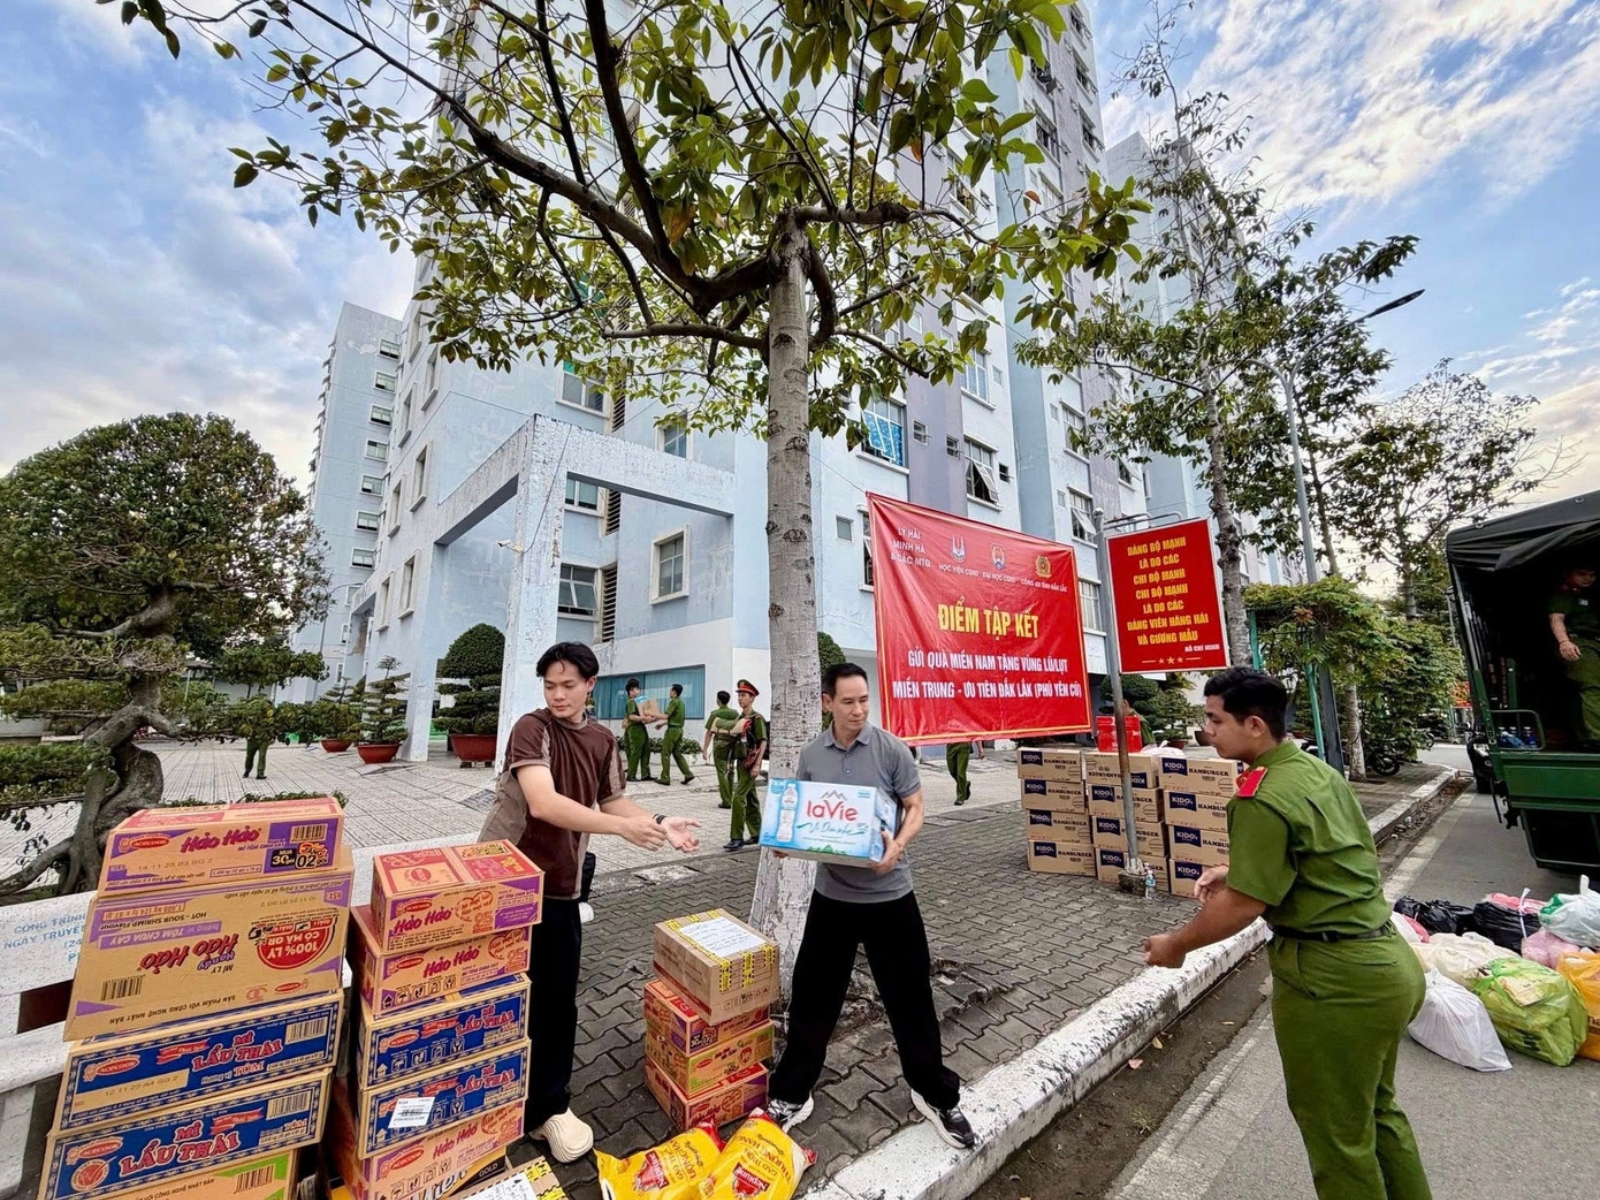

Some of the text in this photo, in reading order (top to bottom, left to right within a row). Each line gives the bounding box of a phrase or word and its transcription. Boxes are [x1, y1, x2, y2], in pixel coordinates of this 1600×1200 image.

[892, 540, 914, 550] MINH
[1150, 540, 1160, 553] BỘ
[1163, 537, 1186, 550] MẠNH
[1139, 554, 1180, 569] LÀ DO CÁC
[1133, 569, 1186, 585] CHI BỘ MẠNH
[1136, 584, 1188, 600] CHI BỘ MẠNH
[1143, 600, 1184, 614] LÀ DO CÁC
[938, 596, 1039, 640] ĐIỂM TẬP KẾT
[1150, 617, 1168, 628] VIÊN
[1194, 612, 1209, 624] HÁI
[1137, 634, 1148, 645] VÀ
[908, 645, 924, 668] GỬI
[927, 648, 949, 669] QUÀ
[974, 655, 997, 670] NAM
[997, 653, 1020, 674] TẶNG
[1020, 654, 1042, 672] VÙNG
[922, 682, 955, 698] TRUNG
[963, 681, 976, 698] ƯU
[976, 680, 997, 698] TIÊN
[998, 677, 1016, 698] ĐẮK
[1016, 677, 1034, 698] LẮK
[1054, 680, 1069, 697] YÊN
[1188, 768, 1229, 776] HAMBURGER
[806, 800, 858, 821] laVie
[180, 825, 260, 853] Hảo Hảo
[132, 917, 162, 927] SHRIMP
[164, 914, 185, 922] SOUR
[394, 914, 423, 934] Hảo
[425, 906, 452, 925] Hảo
[109, 936, 132, 946] CAY
[134, 931, 161, 942] CHUA
[162, 928, 184, 938] TÔM
[304, 931, 320, 939] CÓ
[140, 933, 240, 975] Hảo Hảo
[267, 941, 317, 960] 100% LY
[210, 966, 221, 974] LY
[423, 956, 451, 978] Hảo
[452, 946, 480, 966] Hảo
[202, 998, 221, 1007] PHẨM
[126, 1012, 145, 1021] NHẬT
[233, 1030, 255, 1047] MÌ
[191, 1043, 235, 1072] LẨU
[235, 1038, 283, 1062] THÁI
[174, 1120, 204, 1142] MÌ
[433, 1139, 455, 1159] Hảo
[456, 1123, 478, 1144] Hảo
[118, 1138, 178, 1178] LẨU
[177, 1130, 241, 1163] THÁI
[479, 1162, 498, 1177] GOLD
[735, 1167, 768, 1190] Neptune
